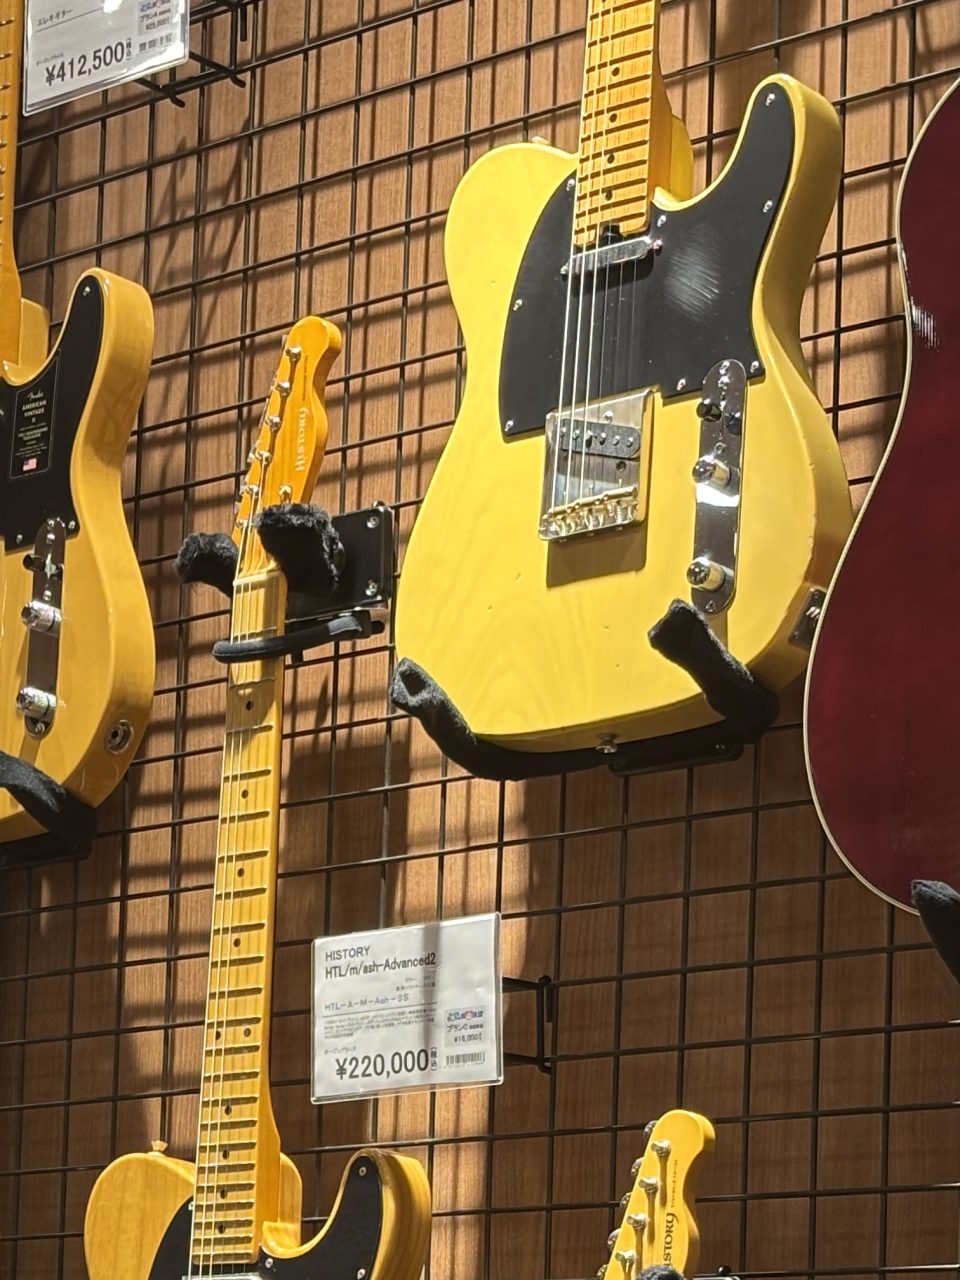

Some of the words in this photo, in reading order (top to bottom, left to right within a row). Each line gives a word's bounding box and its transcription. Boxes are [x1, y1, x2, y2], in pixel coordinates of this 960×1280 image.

[45, 42, 124, 86] ¥412,500
[22, 400, 46, 410] AMERICAN
[325, 946, 371, 962] HISTORY
[325, 953, 437, 980] HTL/m/ash-Advanced2
[335, 1049, 429, 1081] ¥220,000
[663, 1213, 679, 1267] ISTORY
